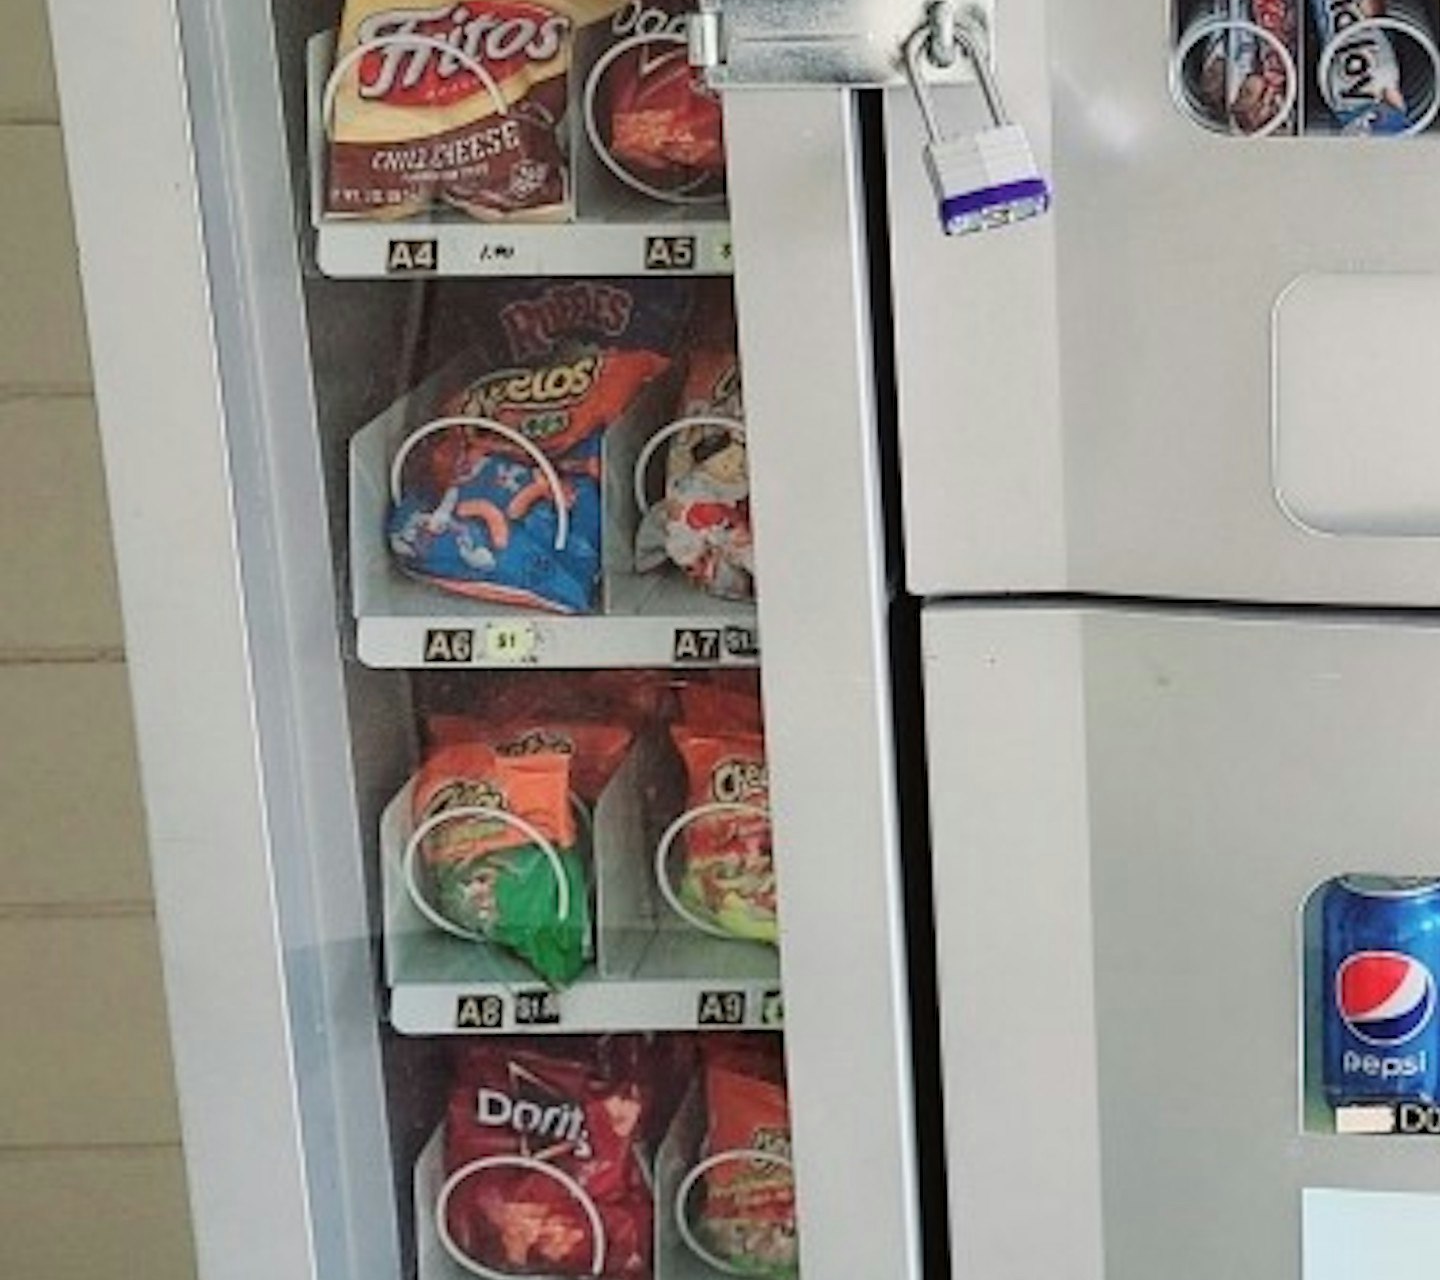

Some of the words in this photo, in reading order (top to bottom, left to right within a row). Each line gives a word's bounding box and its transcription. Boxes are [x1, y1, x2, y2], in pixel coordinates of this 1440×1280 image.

[358, 4, 571, 99] Fritos
[1334, 36, 1378, 101] Joy
[390, 242, 436, 270] A4
[648, 238, 695, 268] A5
[427, 632, 472, 660] A6
[677, 631, 718, 659] A7
[459, 998, 501, 1026] A8
[700, 993, 742, 1023] A9
